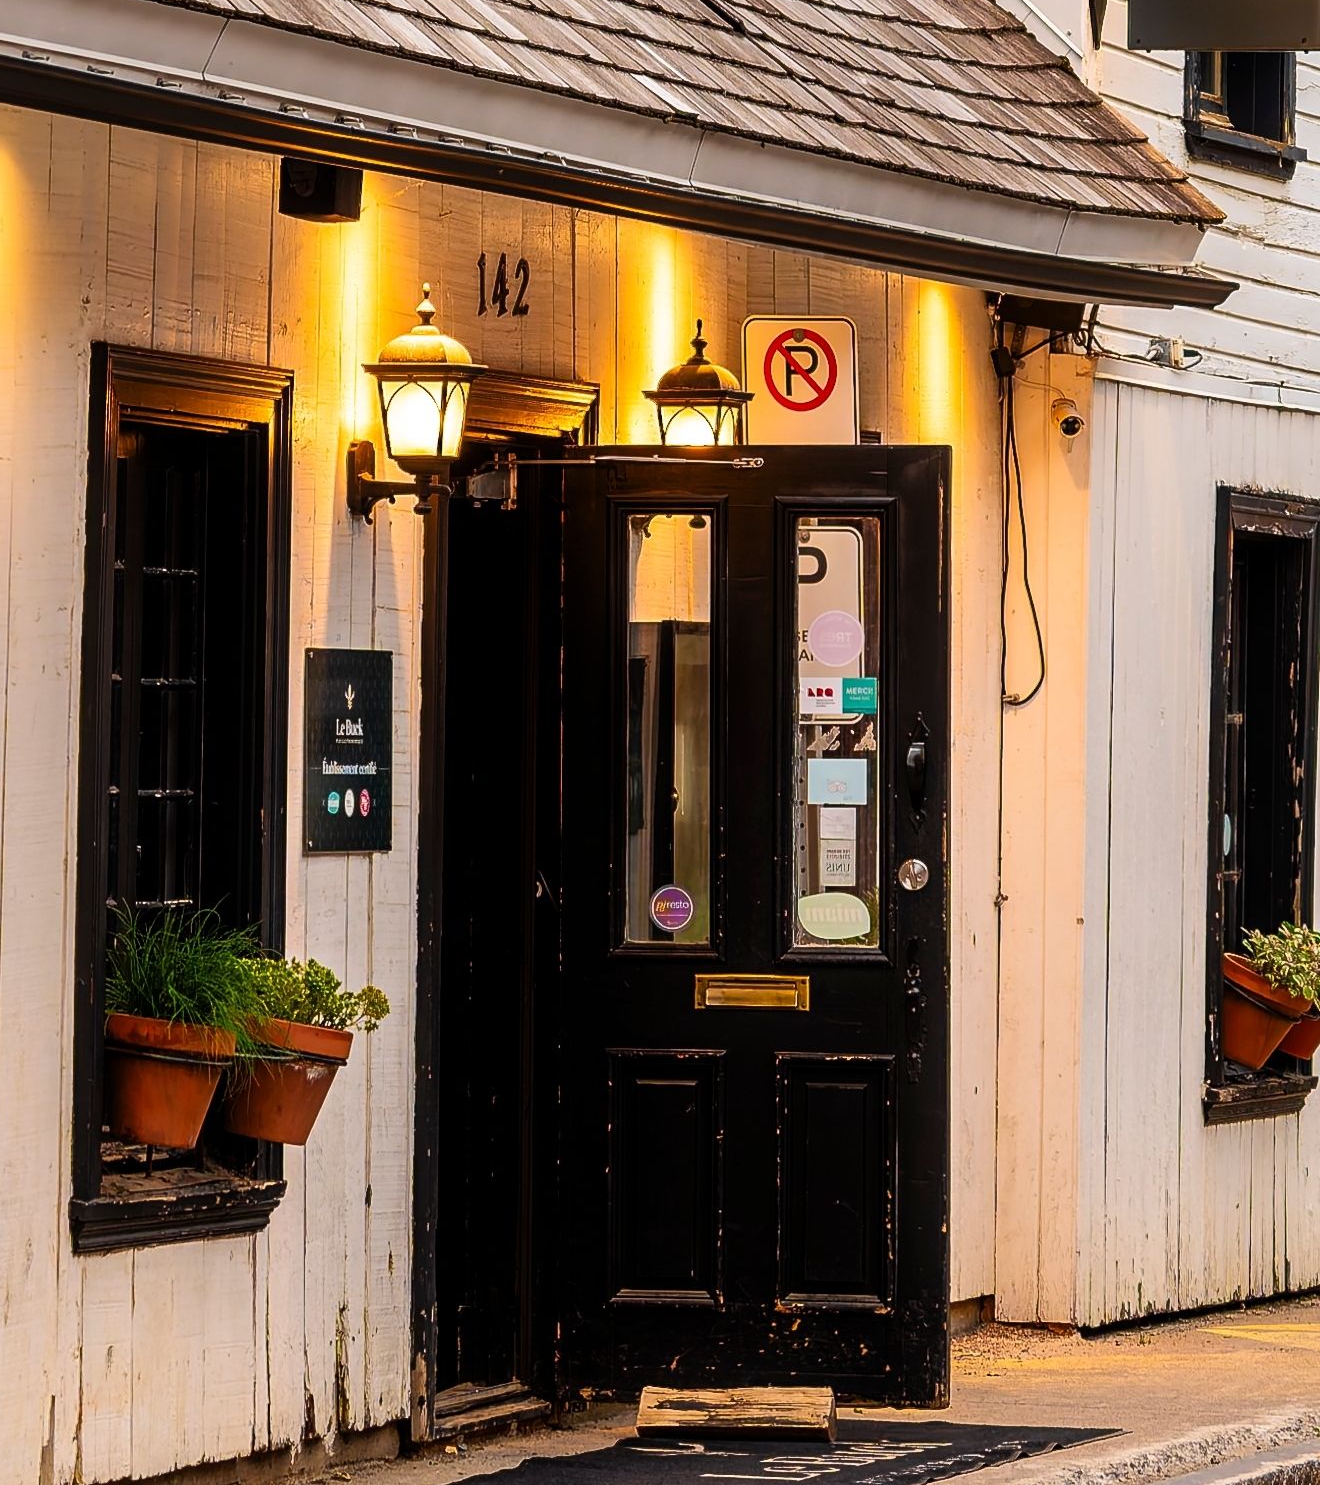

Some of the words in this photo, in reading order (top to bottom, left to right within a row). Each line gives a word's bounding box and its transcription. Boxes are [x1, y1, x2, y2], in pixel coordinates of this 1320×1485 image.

[476, 251, 531, 318] 142
[336, 718, 345, 736] Le
[346, 717, 364, 736] Buck
